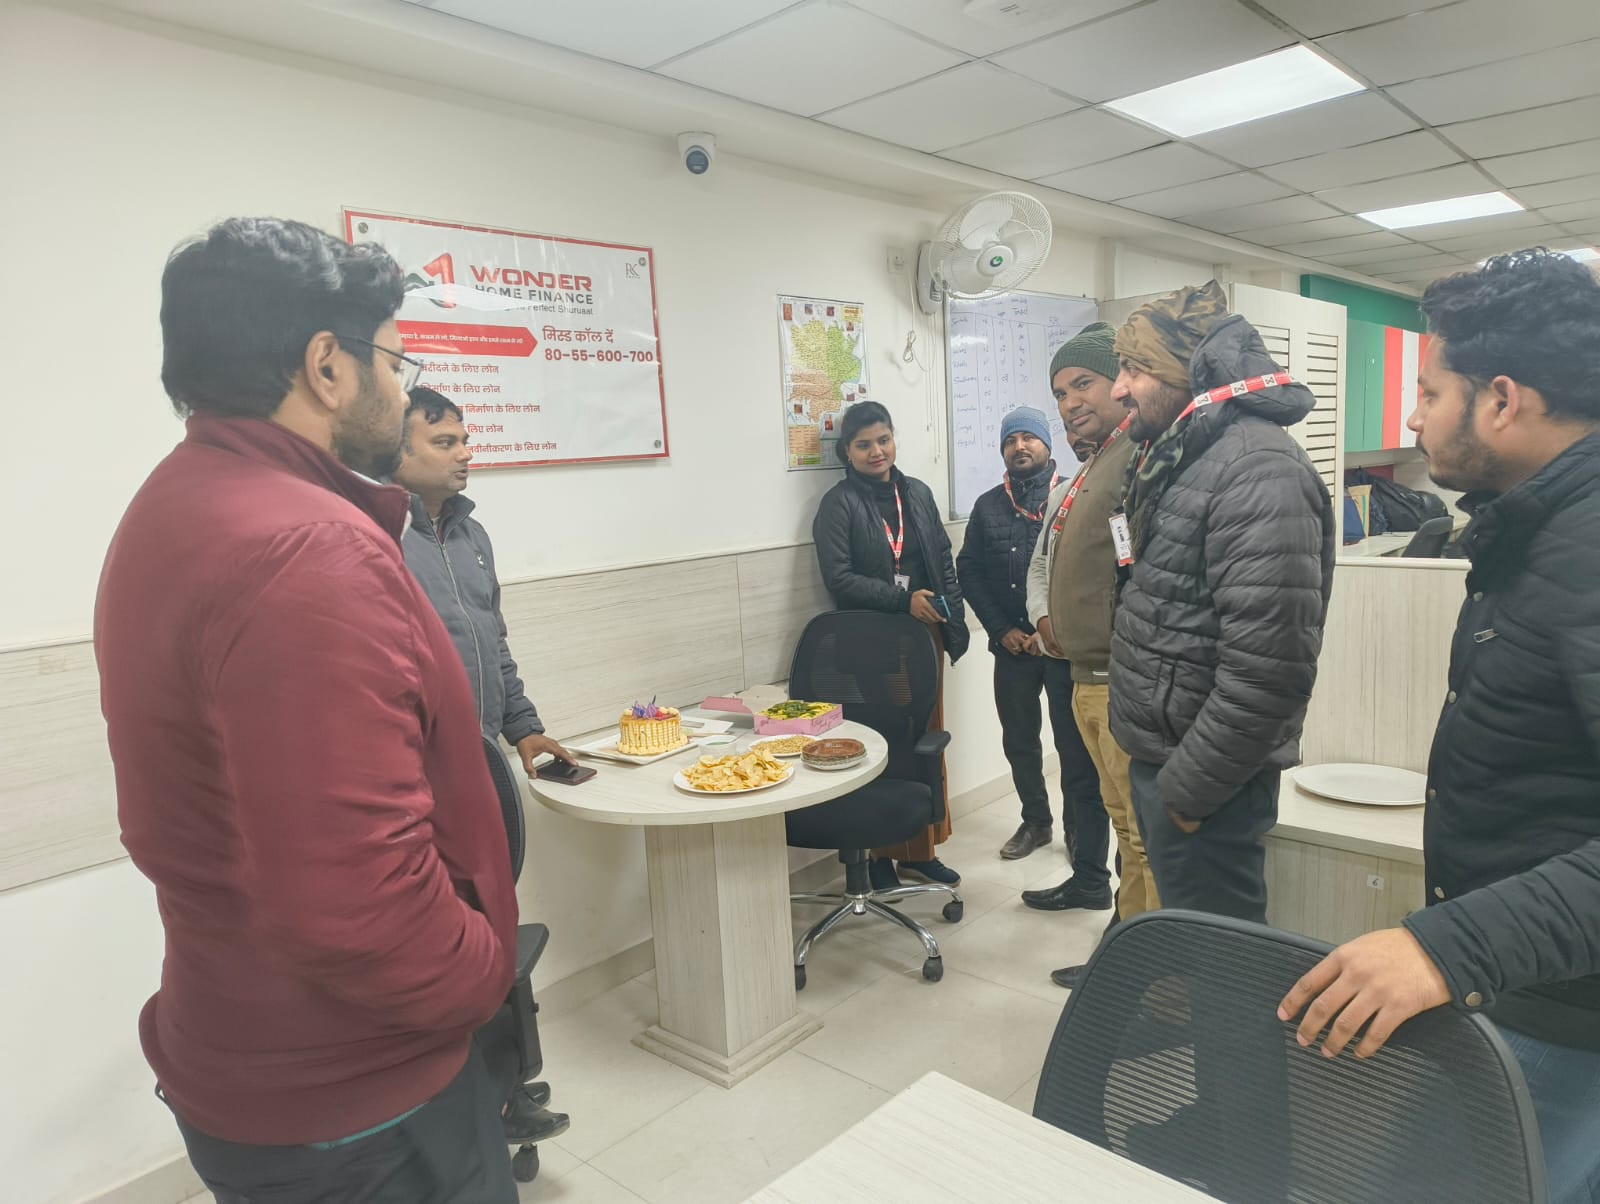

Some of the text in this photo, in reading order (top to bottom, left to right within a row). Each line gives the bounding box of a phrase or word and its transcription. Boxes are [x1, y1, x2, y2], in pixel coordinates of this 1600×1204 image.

[469, 264, 593, 292] WONDER
[474, 284, 594, 305] HOME FINANCE
[542, 325, 572, 342] मिस्ड
[573, 327, 603, 343] कॉल
[604, 328, 614, 344] दें
[544, 348, 654, 363] 80-55-600-700
[451, 362, 460, 373] के
[461, 362, 479, 373] लिए
[481, 363, 499, 374] लोन
[453, 383, 462, 393] के
[463, 383, 481, 393] लिए
[482, 384, 501, 393] लोन
[465, 403, 493, 413] निर्माण
[495, 403, 504, 413] के
[505, 403, 521, 413] लिए
[523, 403, 541, 413] लोन
[467, 423, 504, 433] लिए लोन
[514, 442, 523, 451] के
[524, 441, 540, 451] लिए
[542, 441, 557, 451] लोन
